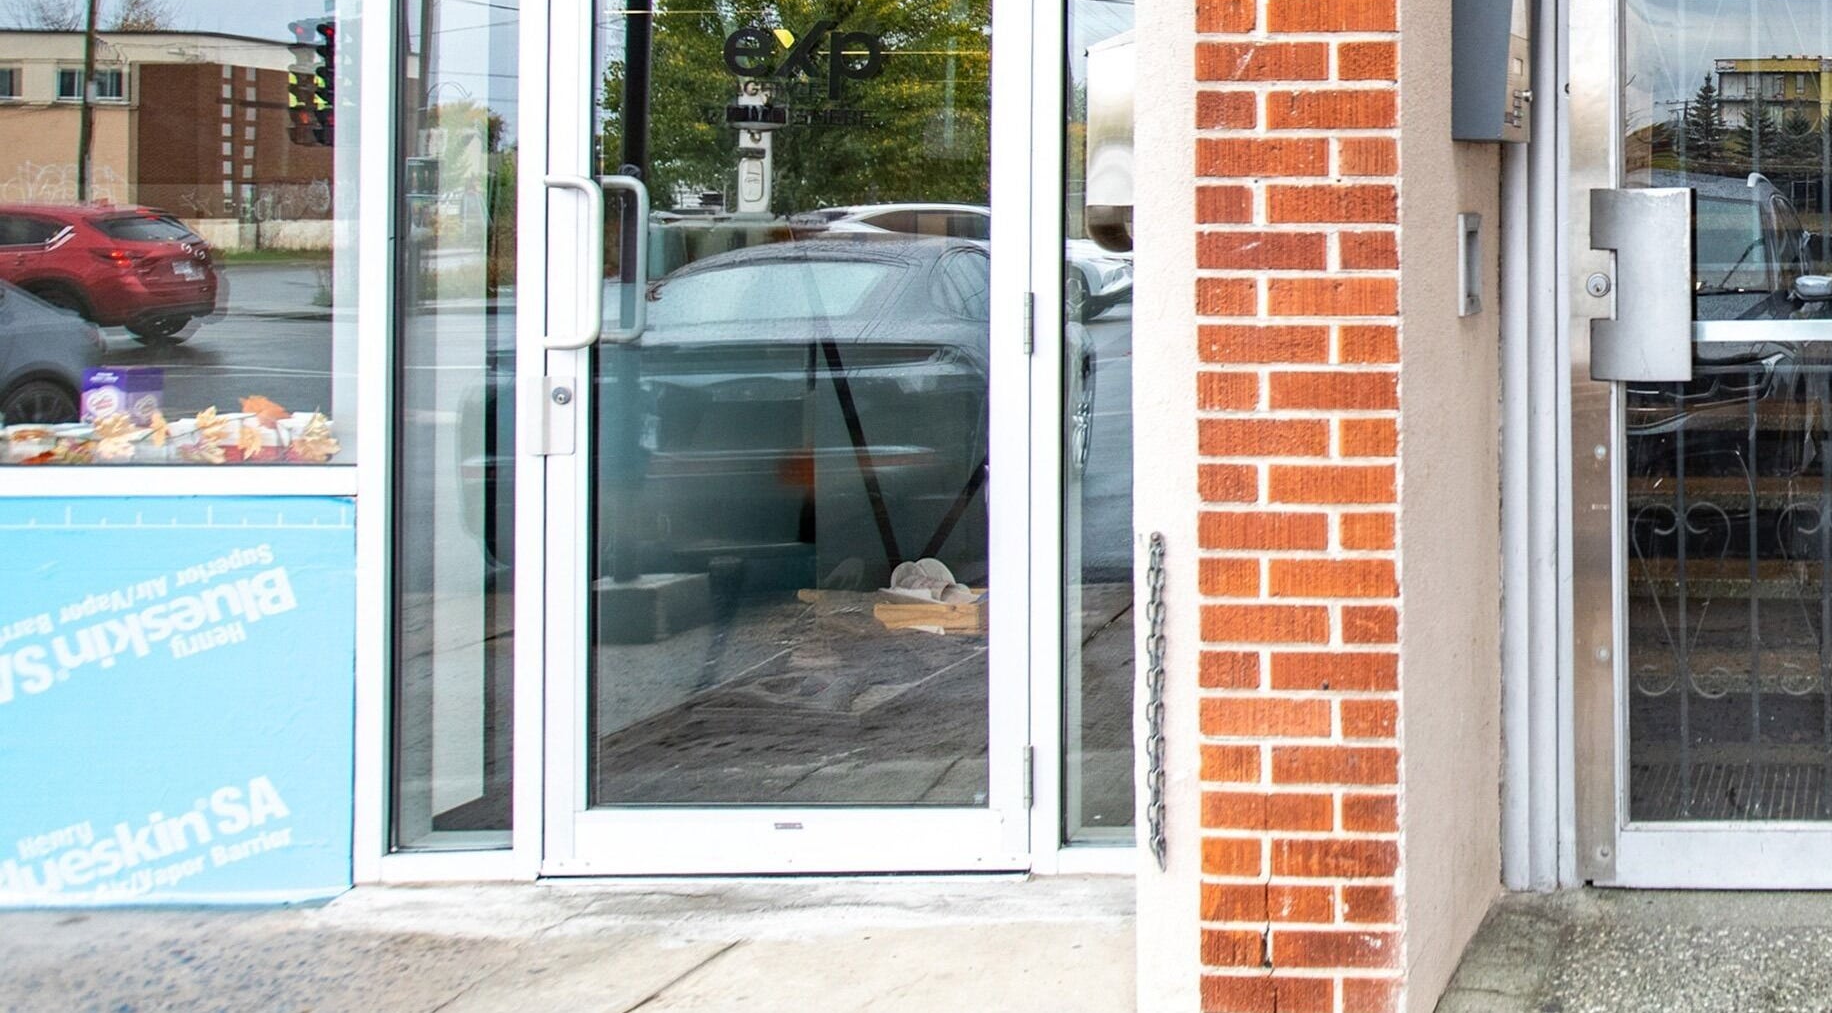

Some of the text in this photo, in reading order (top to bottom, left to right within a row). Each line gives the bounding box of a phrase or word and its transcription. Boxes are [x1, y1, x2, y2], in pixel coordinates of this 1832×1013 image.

[168, 621, 248, 659] Henry
[0, 811, 211, 893] lueskin
[17, 819, 95, 860] Henry
[210, 827, 293, 867] Barrier
